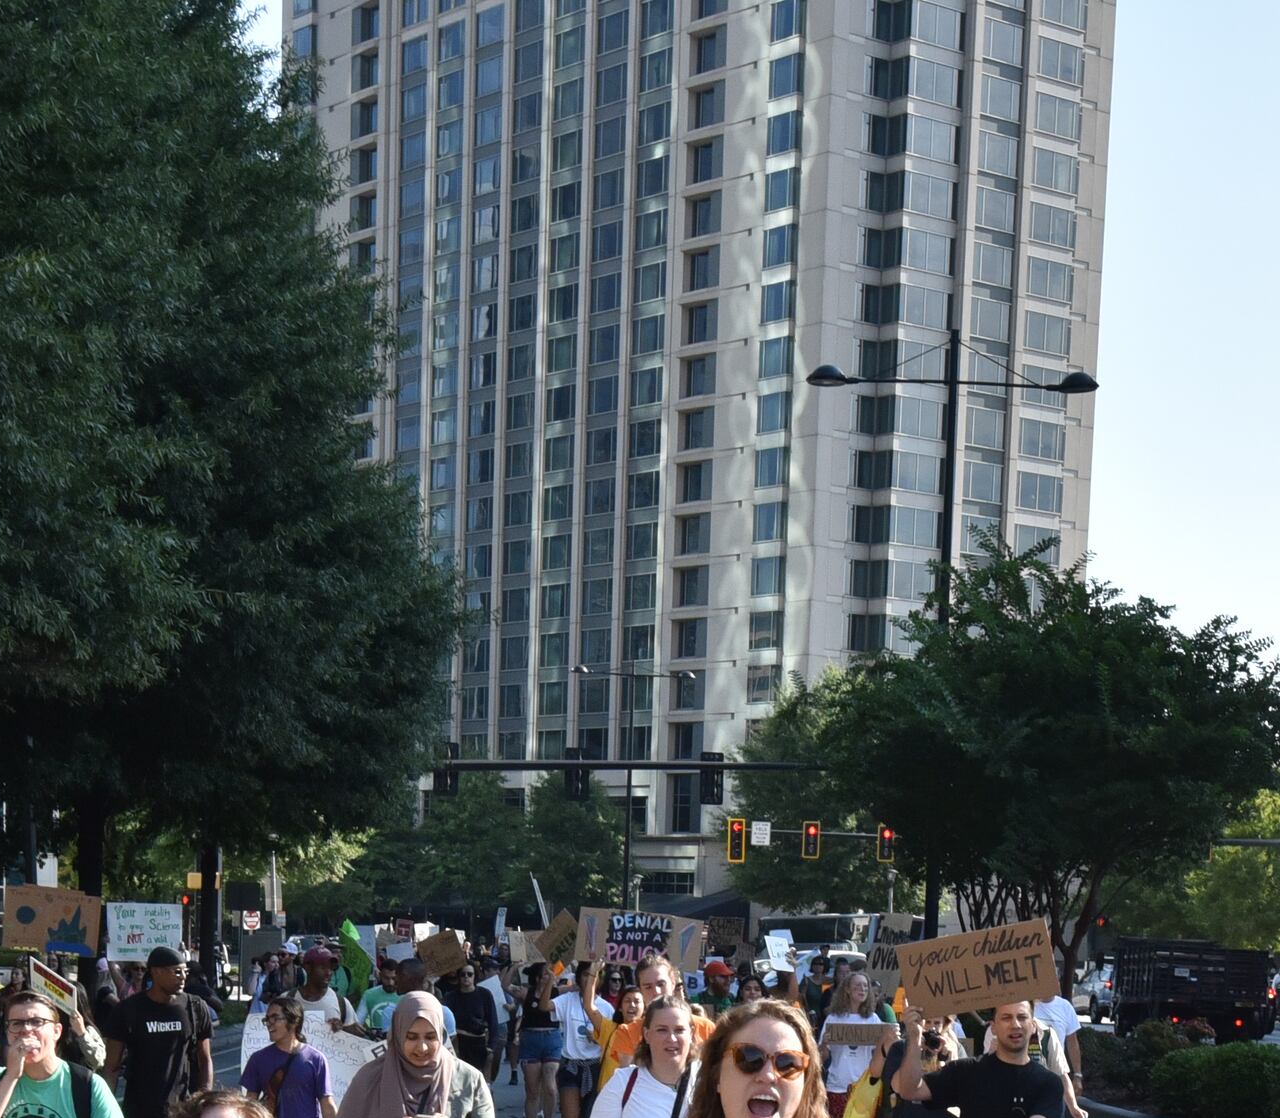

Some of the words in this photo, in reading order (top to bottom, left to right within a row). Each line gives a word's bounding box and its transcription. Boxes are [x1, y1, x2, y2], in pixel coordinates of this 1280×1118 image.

[612, 913, 672, 932] DENIAL
[127, 932, 144, 944] NOT
[613, 932, 622, 940] IS
[626, 932, 649, 942] NOT
[653, 934, 661, 942] A
[909, 945, 967, 986] your
[973, 929, 1043, 957] children
[924, 968, 982, 998] WILL
[984, 954, 1042, 989] MELT
